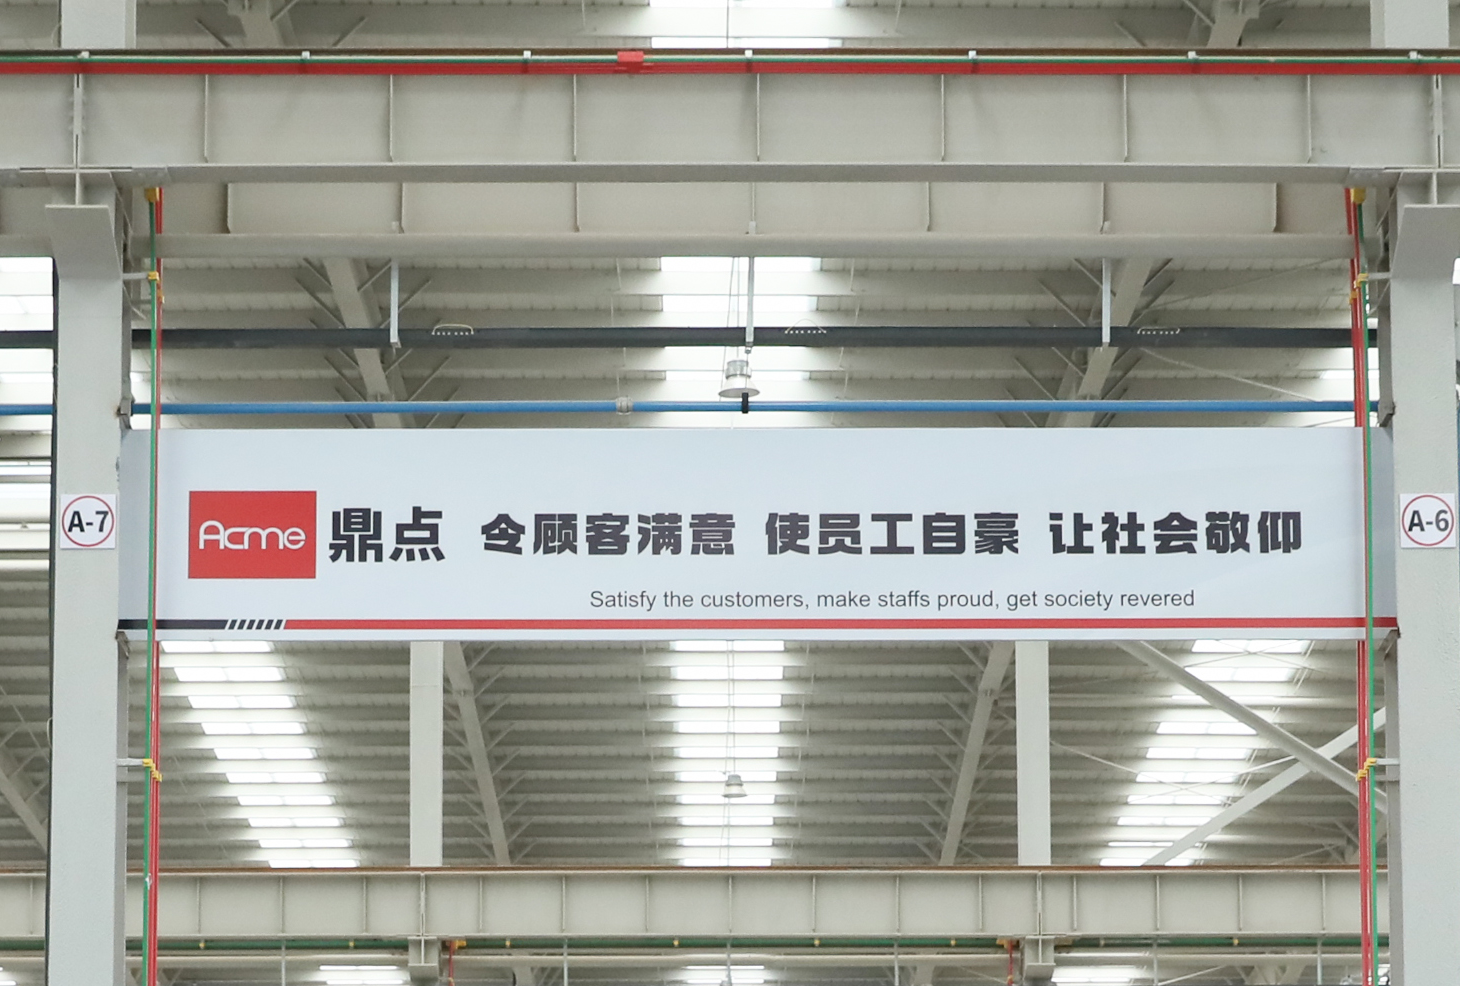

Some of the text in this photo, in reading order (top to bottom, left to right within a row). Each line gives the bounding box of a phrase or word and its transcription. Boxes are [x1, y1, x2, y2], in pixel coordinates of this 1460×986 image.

[66, 509, 110, 534] A-7
[328, 506, 1302, 562] 鼎点 令顾客满意 使员工自豪 让社会敬仰
[1406, 509, 1450, 534] A-6
[198, 520, 306, 550] Acme
[590, 589, 1195, 612] Satisfy the customers, make staffs proud, get society revered
